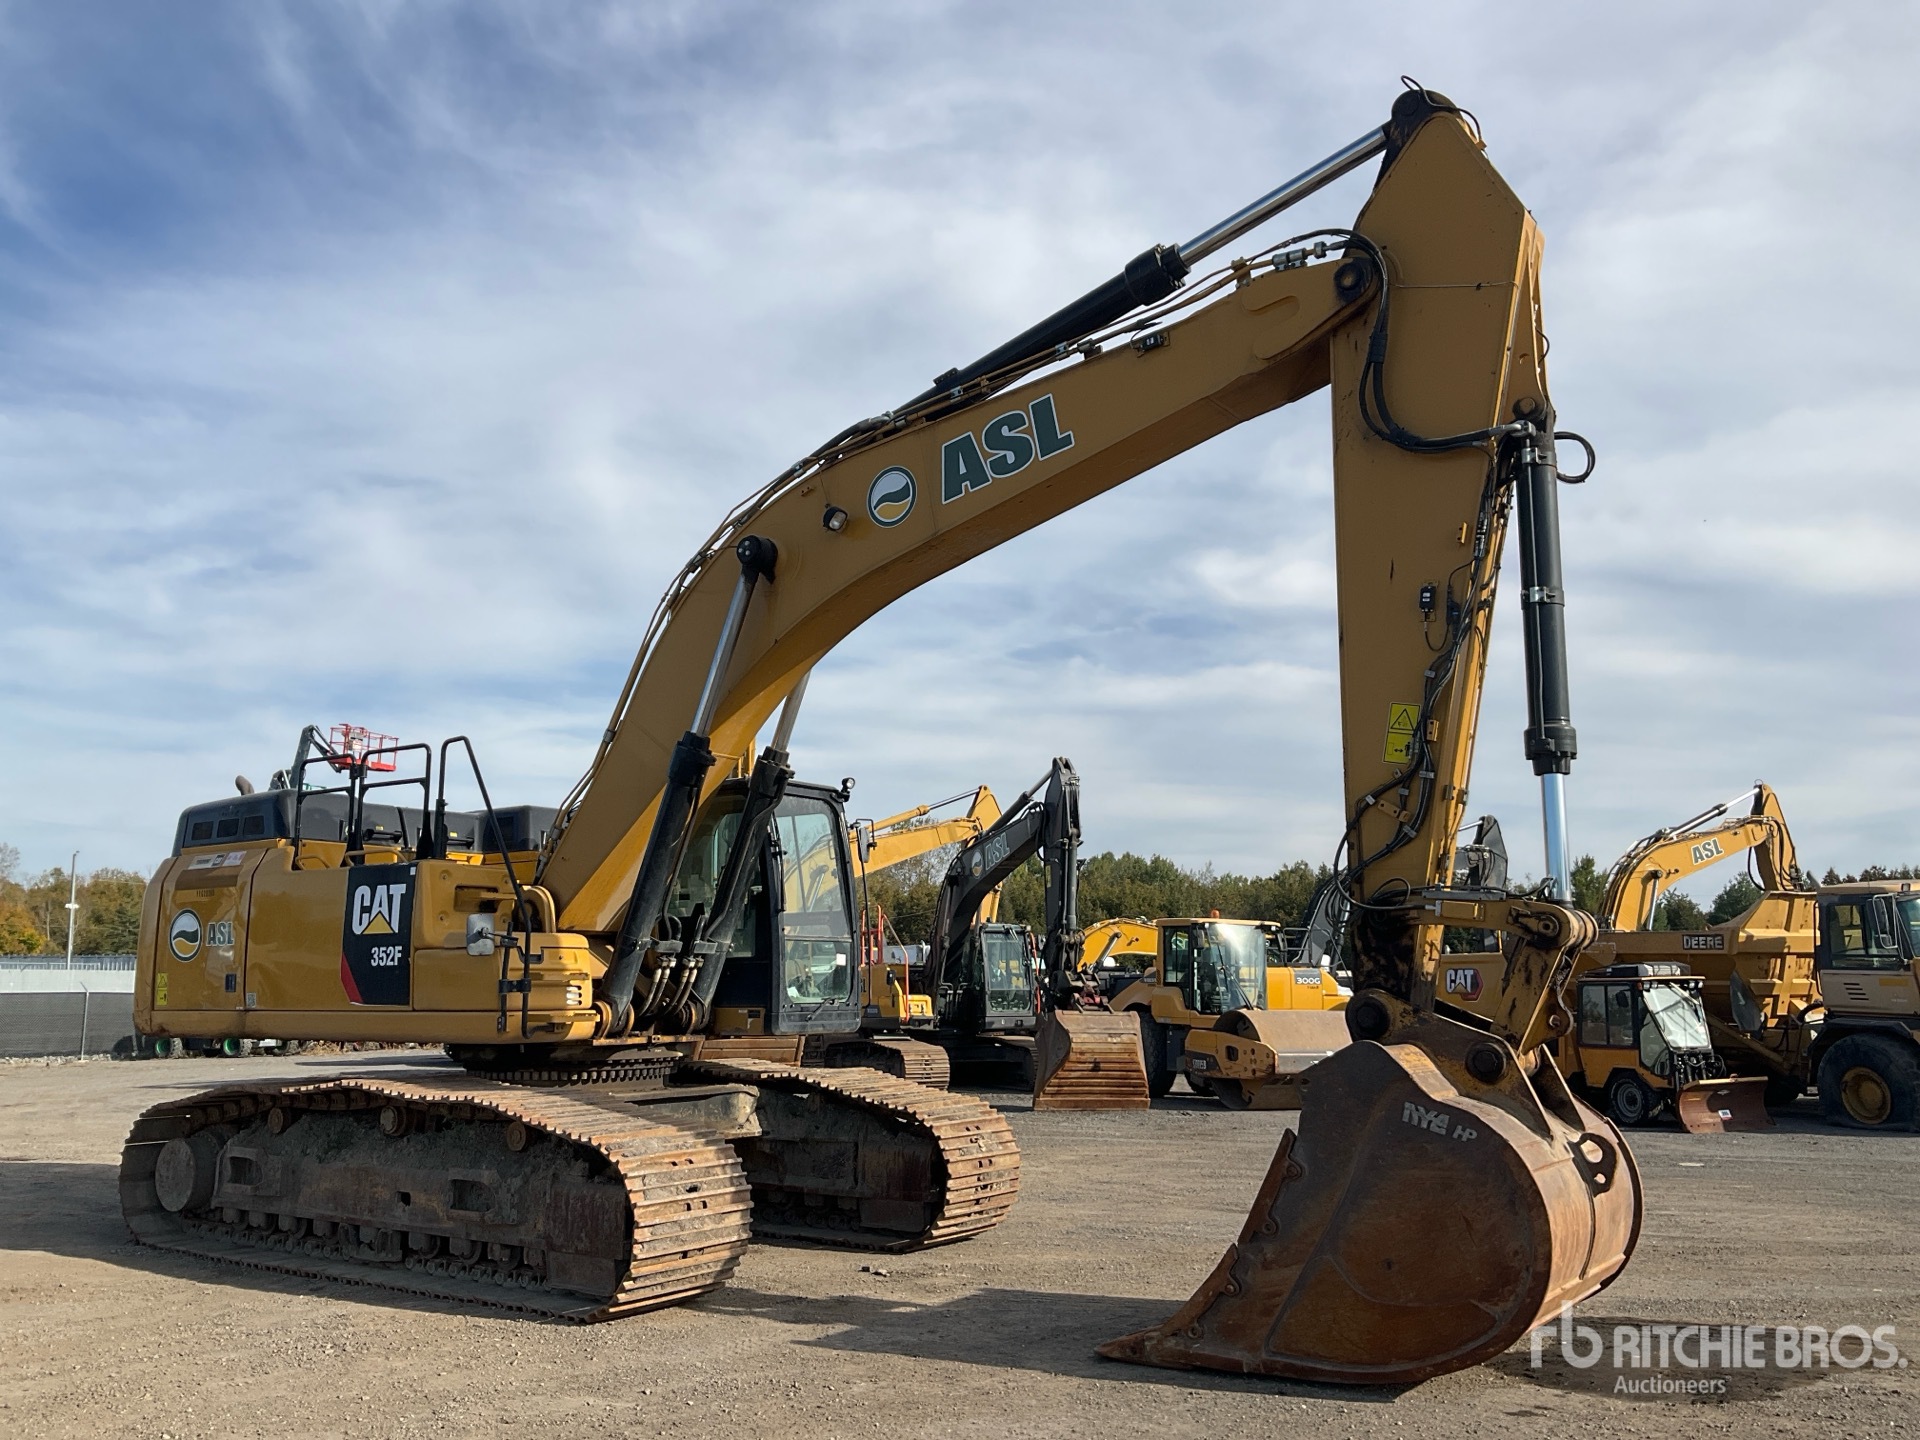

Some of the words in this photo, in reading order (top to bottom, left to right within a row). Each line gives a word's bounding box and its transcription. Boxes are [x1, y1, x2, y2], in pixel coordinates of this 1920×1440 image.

[941, 393, 1075, 504] ASL
[985, 831, 1011, 871] ASL
[1692, 838, 1724, 866] ASL
[352, 884, 407, 935] CAT
[206, 922, 235, 947] ASL
[1683, 935, 1724, 950] DEERE
[371, 946, 403, 967] 352F
[1296, 977, 1321, 985] 300G
[1446, 969, 1474, 993] CAT
[1452, 1125, 1478, 1142] HP
